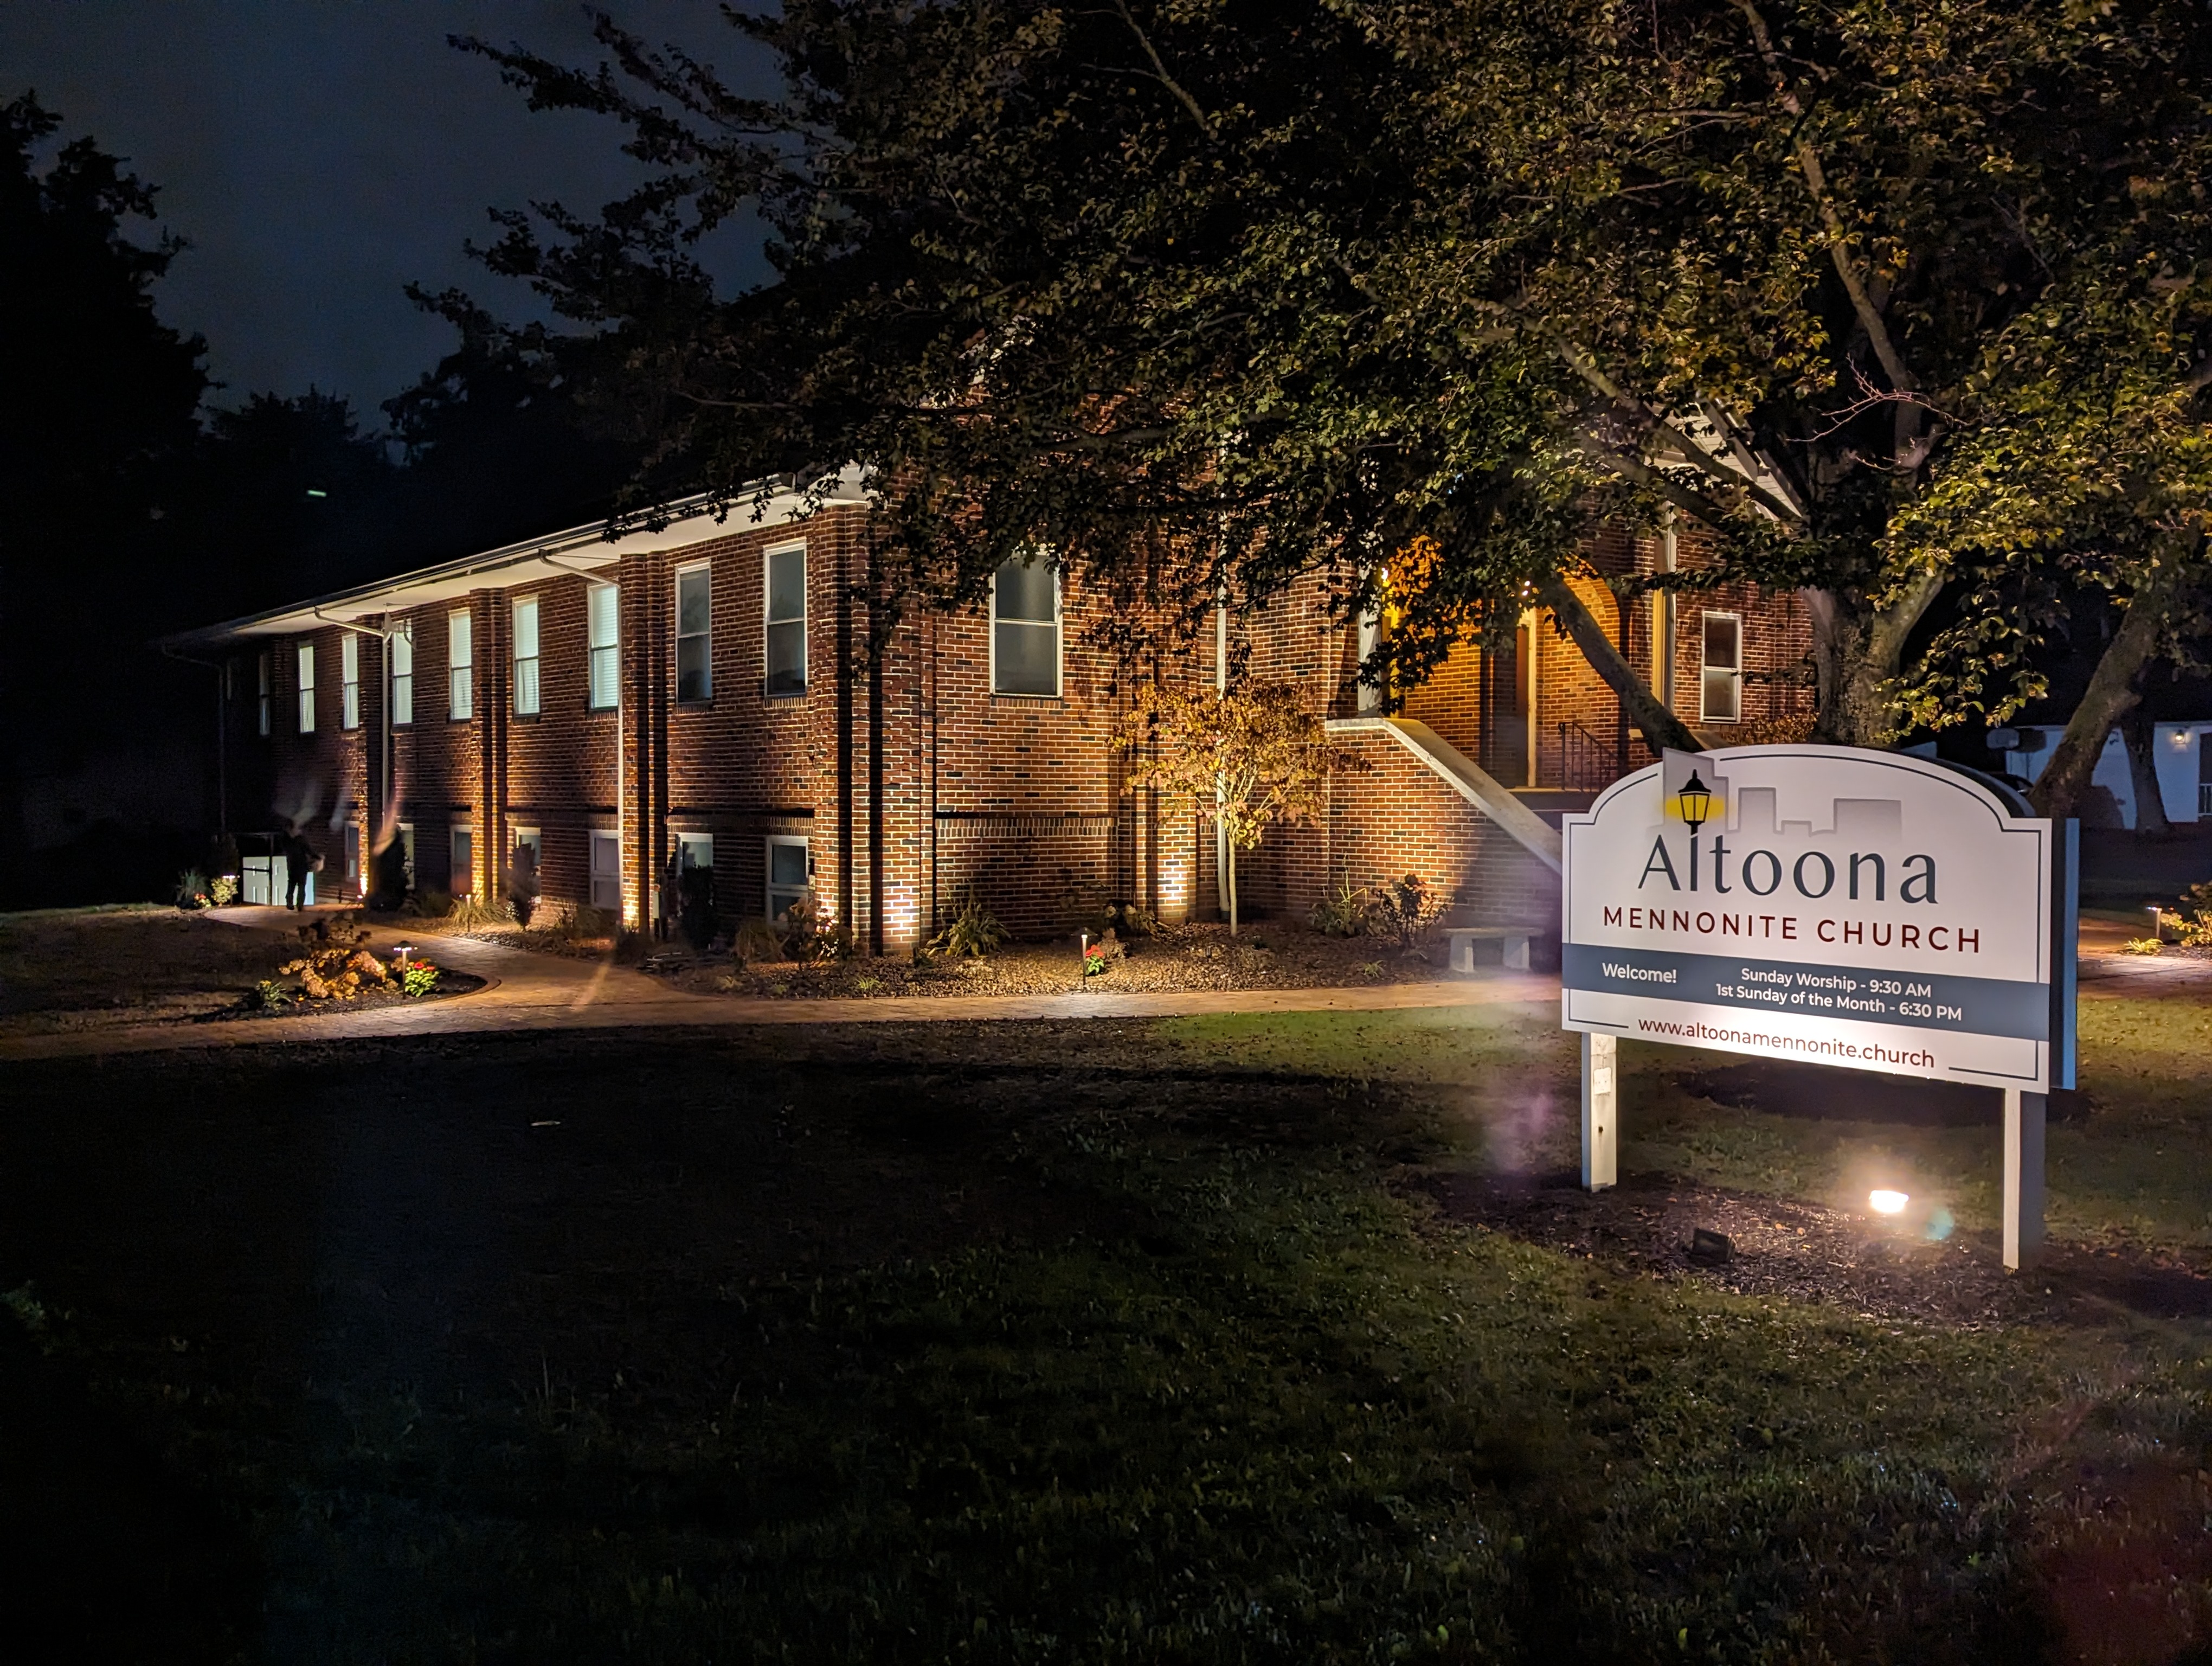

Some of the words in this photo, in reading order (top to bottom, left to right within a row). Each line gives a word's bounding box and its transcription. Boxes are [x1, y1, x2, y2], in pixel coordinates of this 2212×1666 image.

[1638, 834, 1939, 904] Altoona
[1603, 906, 1797, 940] MENNONITE
[1817, 919, 1979, 953] CHURCH
[1602, 962, 1677, 984] Welcome!
[1741, 967, 1793, 987] Sunday
[1796, 972, 1857, 992] Worship
[1869, 979, 1902, 995] 9:30
[1905, 983, 1932, 998] AM
[1716, 984, 1733, 997] 1st
[1737, 985, 1787, 1005] Sunday
[1791, 991, 1806, 1004] of
[1808, 993, 1833, 1007] the
[1837, 996, 1885, 1013] Month
[1899, 1002, 1932, 1018] 6:30
[1937, 1005, 1962, 1021] PM
[1638, 1019, 1934, 1068] www.altoonamennonite.church
